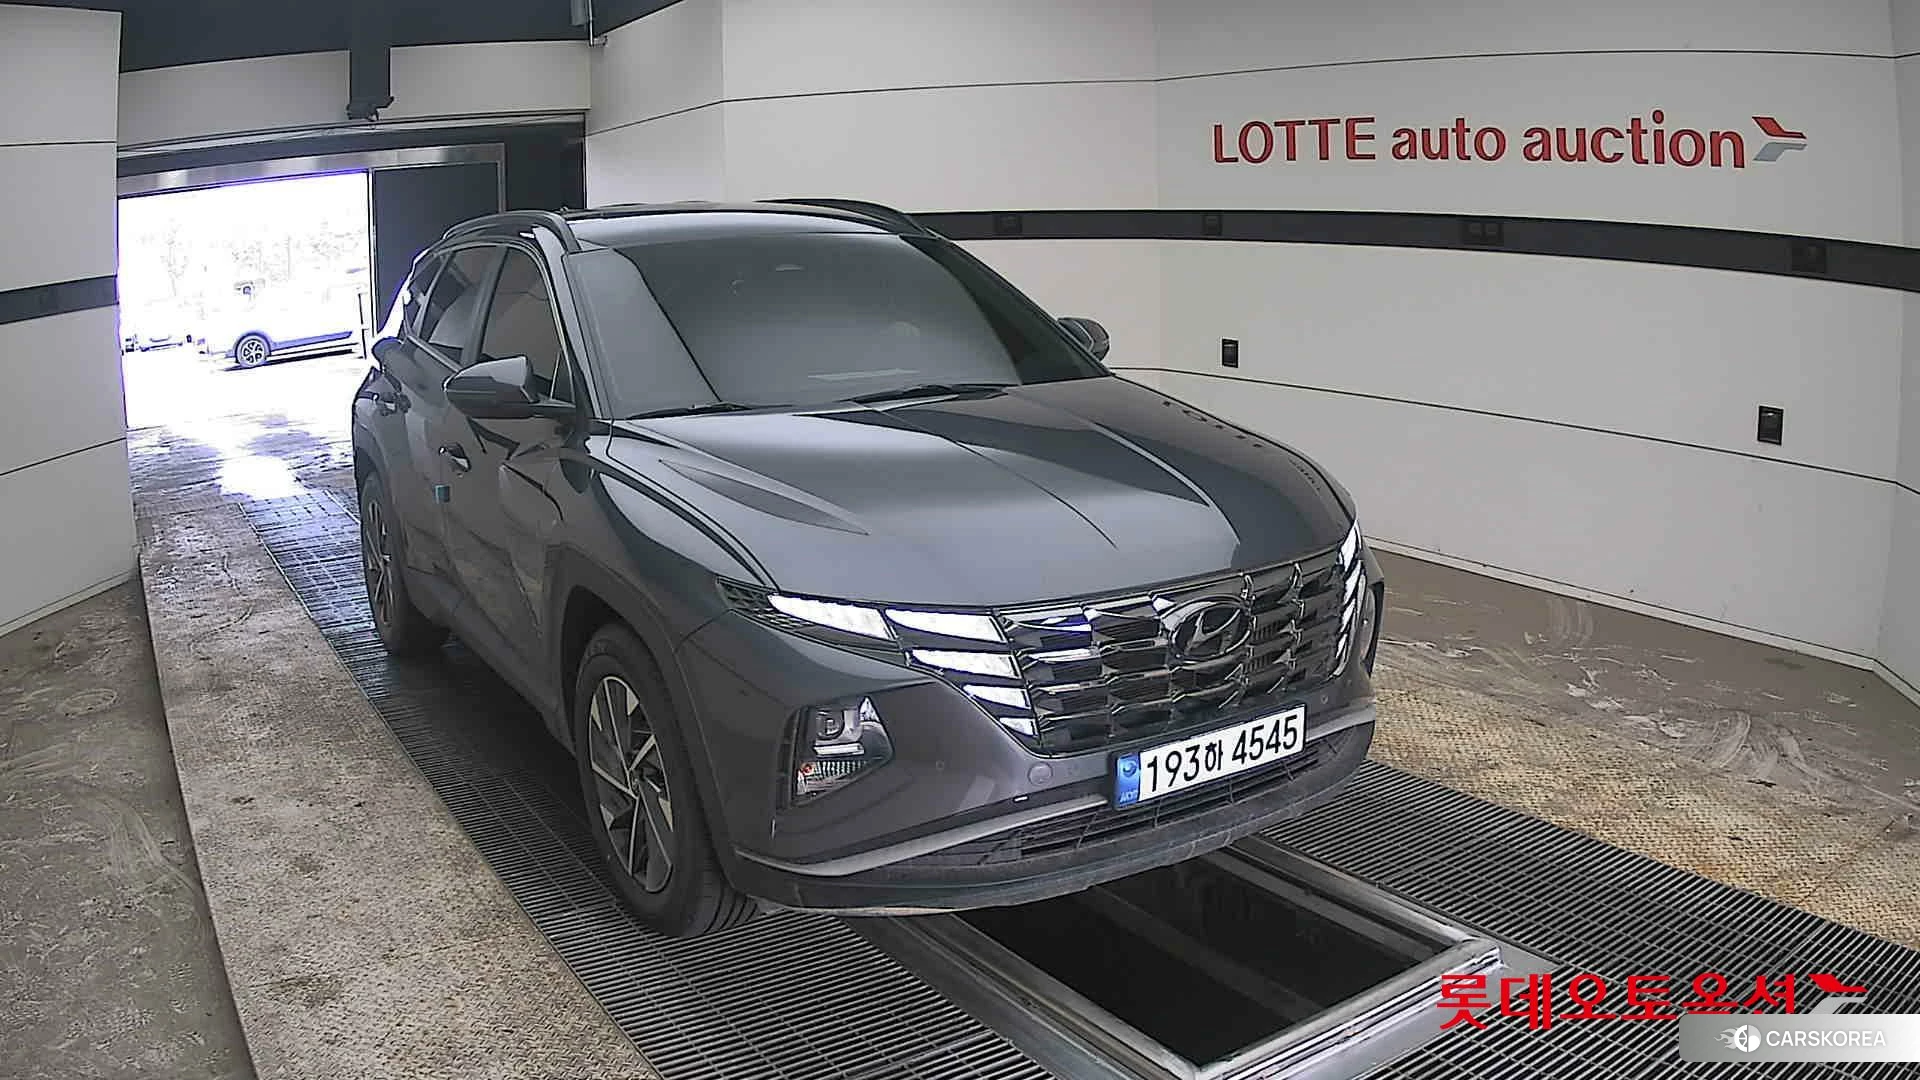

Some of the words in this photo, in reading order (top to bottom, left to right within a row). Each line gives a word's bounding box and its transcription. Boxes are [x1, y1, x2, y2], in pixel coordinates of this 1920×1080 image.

[1213, 117, 1376, 163] LOTTE
[1393, 117, 1507, 162] auto
[1523, 110, 1745, 168] auction
[1147, 739, 1223, 793] 193하
[1232, 715, 1298, 765] 4545
